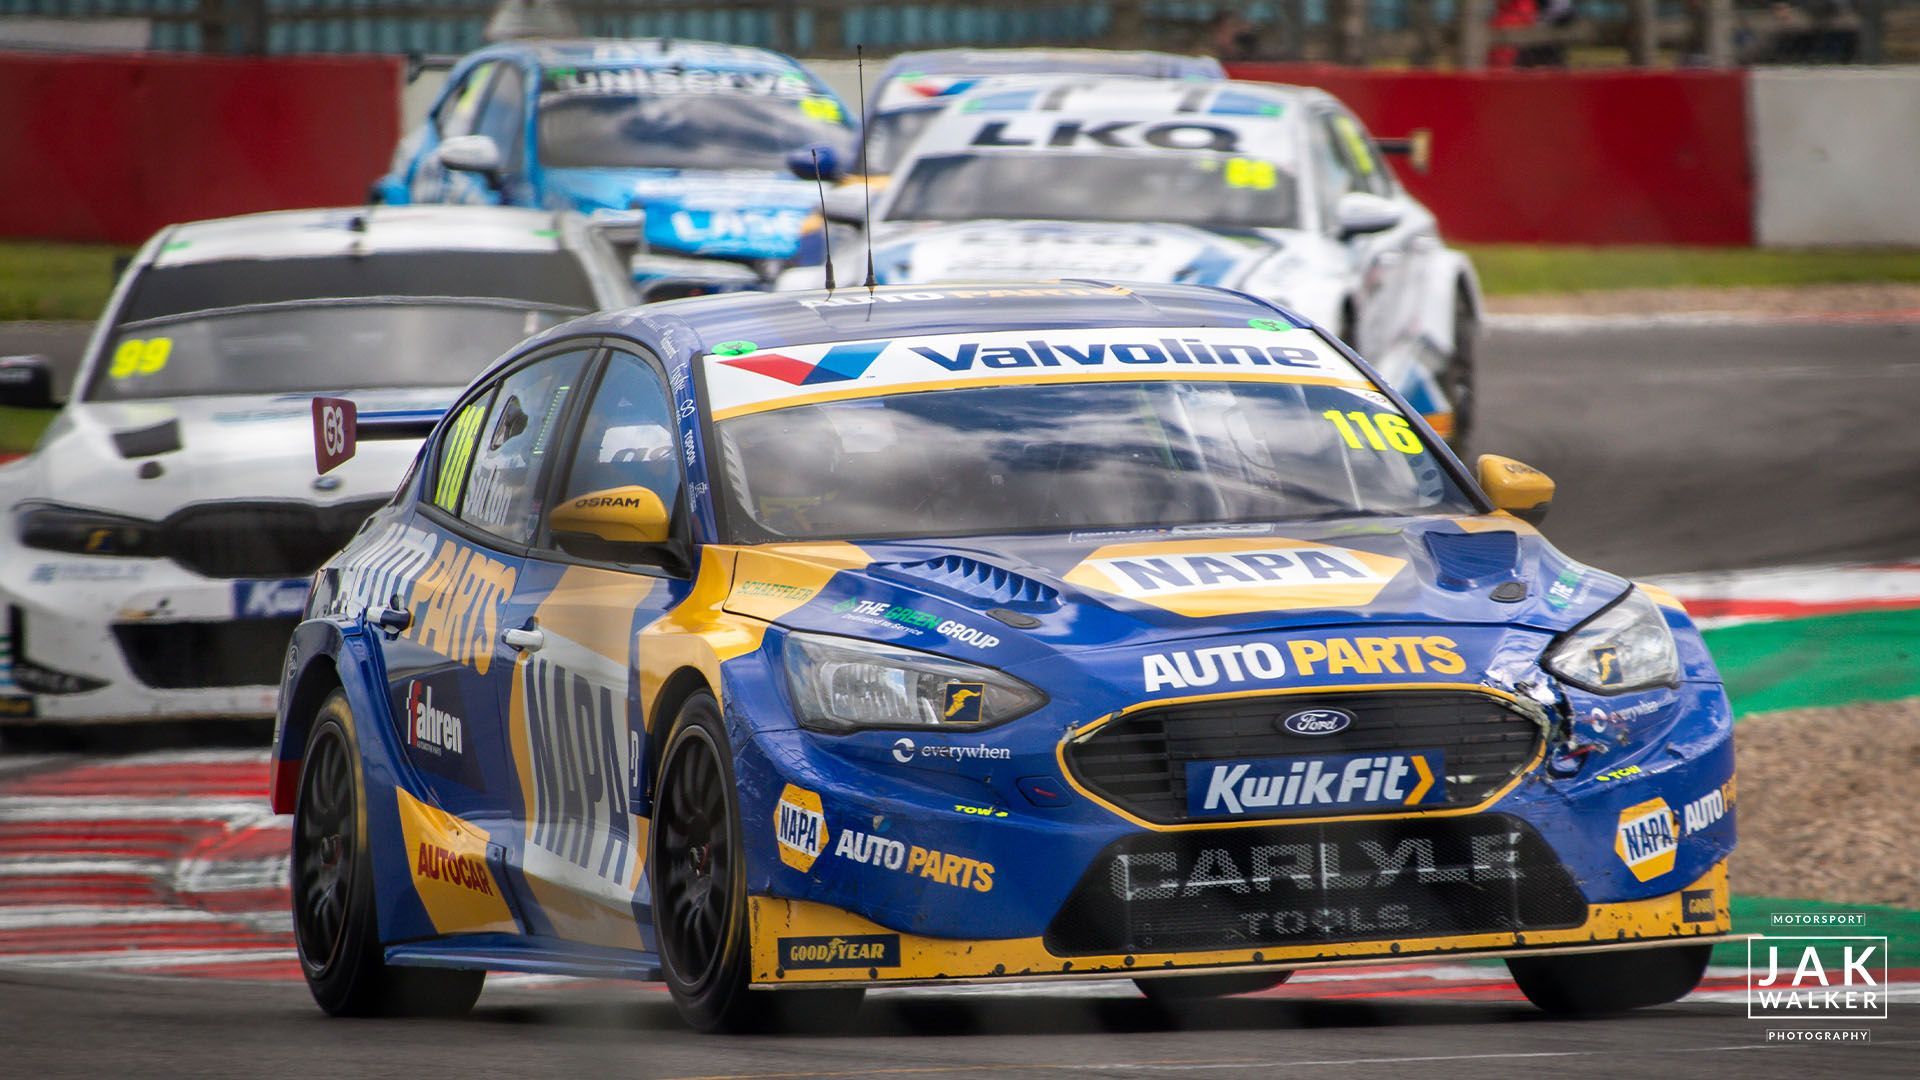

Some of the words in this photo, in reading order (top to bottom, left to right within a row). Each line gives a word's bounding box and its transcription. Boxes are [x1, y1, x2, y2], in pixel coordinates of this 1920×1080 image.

[970, 121, 1240, 152] LKQ
[800, 291, 946, 309] AUTO
[109, 337, 173, 378] 99
[908, 337, 1323, 374] Valvoline
[1322, 410, 1424, 454] 116
[575, 497, 640, 508] OSRAM
[1110, 550, 1367, 591] NAPA
[401, 539, 516, 675] PARTS
[854, 600, 889, 616] THE
[884, 607, 943, 629] GREEN
[937, 621, 1000, 649] GROUP
[1143, 642, 1286, 692] AUTO
[1286, 636, 1467, 676] PARTS
[406, 680, 463, 755] fahren
[1297, 713, 1338, 731] Ford
[525, 654, 629, 885] NAPA
[922, 744, 1011, 762] everywhen
[779, 803, 817, 855] NAPA
[954, 804, 989, 817] TOW
[1684, 789, 1724, 836] AUTO
[1623, 813, 1674, 861] NAPA
[417, 842, 494, 897] AUTOCAR
[835, 828, 905, 871] AUTO
[905, 845, 995, 892] PARTS
[1110, 830, 1527, 901] CARLYLE
[1240, 903, 1410, 936] TOOLS
[790, 941, 885, 964] GOODYEAR
